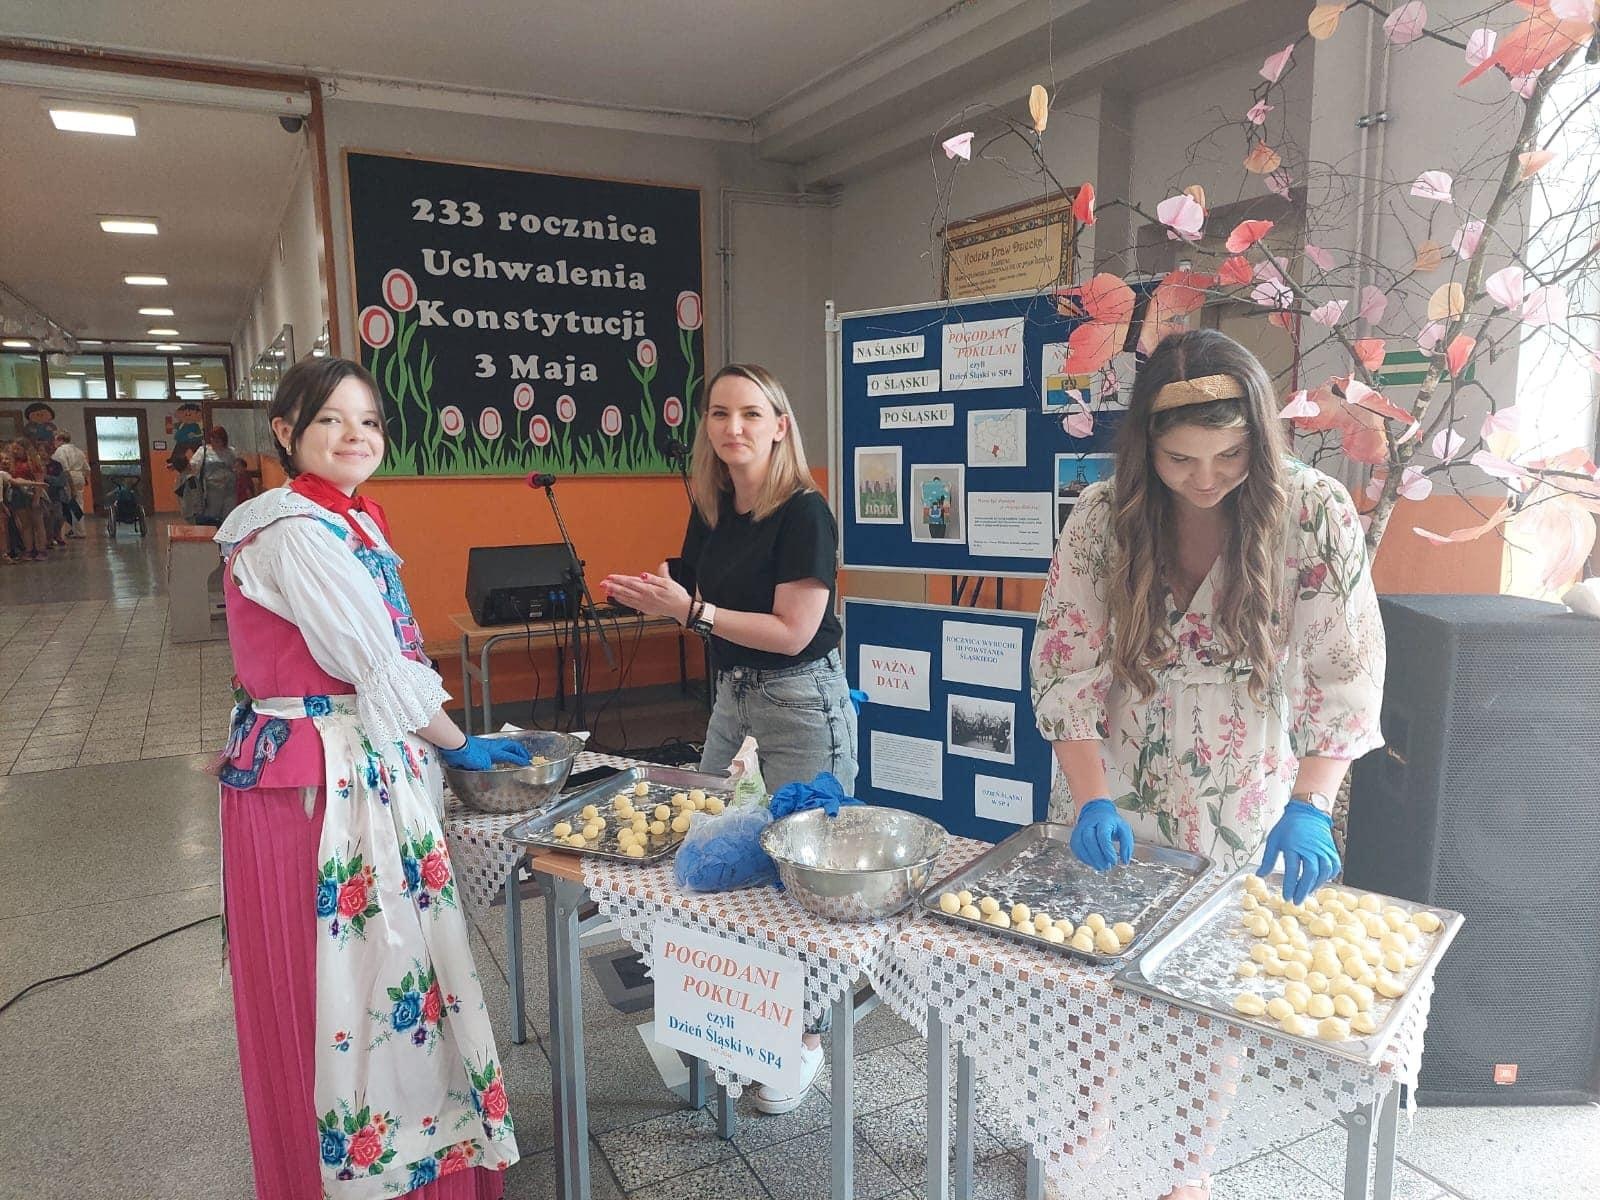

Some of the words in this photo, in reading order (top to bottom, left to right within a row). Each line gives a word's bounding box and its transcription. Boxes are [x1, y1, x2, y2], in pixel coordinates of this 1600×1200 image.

[411, 198, 484, 227] 233
[498, 212, 657, 245] rocznica
[421, 248, 647, 291] Uchwalenia
[417, 300, 646, 341] Konstytucji
[948, 327, 1010, 344] POGODANI
[857, 346, 872, 359] NA
[874, 340, 919, 358] ŚLĄSKU
[957, 343, 1017, 359] POKULANI
[475, 354, 497, 379] 3
[509, 354, 599, 387] Maja
[998, 368, 1013, 378] SP4
[871, 379, 880, 391] O
[884, 374, 930, 392] ŚLĄSKU
[884, 411, 900, 424] PO
[901, 408, 948, 425] ŚLĄSKU
[872, 659, 916, 676] WAŻNA
[877, 676, 909, 690] DATA
[664, 942, 780, 990] POGODANI
[683, 975, 795, 1028] POKULANI
[707, 1012, 735, 1029] czyli
[668, 1015, 702, 1038] Dzień
[706, 1025, 742, 1052] Śląski
[745, 1046, 756, 1057] w
[758, 1047, 783, 1070] SP4
